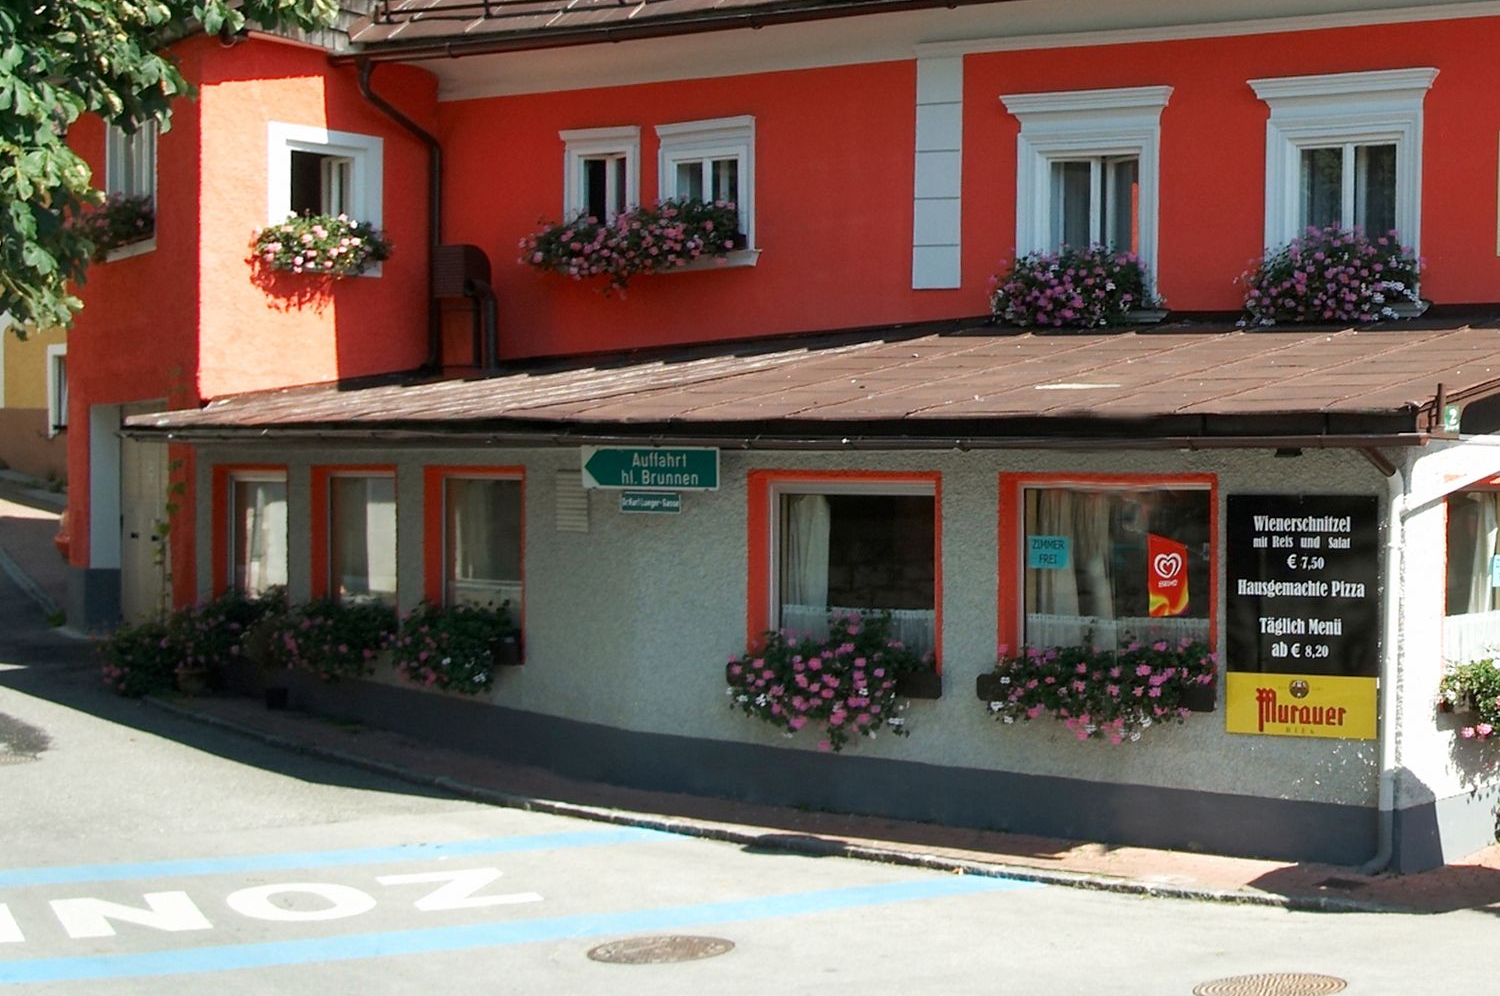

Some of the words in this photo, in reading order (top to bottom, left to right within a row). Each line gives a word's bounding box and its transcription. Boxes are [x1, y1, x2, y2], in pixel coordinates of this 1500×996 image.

[1449, 408, 1457, 424] 2
[631, 452, 688, 468] Auffahrt
[621, 469, 638, 485] hl.
[641, 470, 699, 486] Brunnen
[1253, 515, 1351, 533] Wienerschnitzel
[1032, 539, 1065, 550] ZIMMER
[1253, 536, 1268, 548] mit
[1272, 535, 1294, 548] Reis
[1300, 535, 1321, 549] und
[1328, 536, 1351, 549] Salat
[1039, 554, 1058, 565] FREI
[1286, 554, 1297, 570] €
[1301, 556, 1325, 571] 7,50
[1237, 578, 1329, 598] Hausgemachte
[1331, 580, 1366, 598] Pizza
[1259, 617, 1305, 636] Täglich
[1308, 618, 1343, 636] Menü
[1271, 641, 1288, 658] ab
[1291, 642, 1300, 658] €
[1304, 644, 1329, 659] 8,20
[1256, 687, 1347, 732] Murauer
[0, 866, 544, 943] ZON
